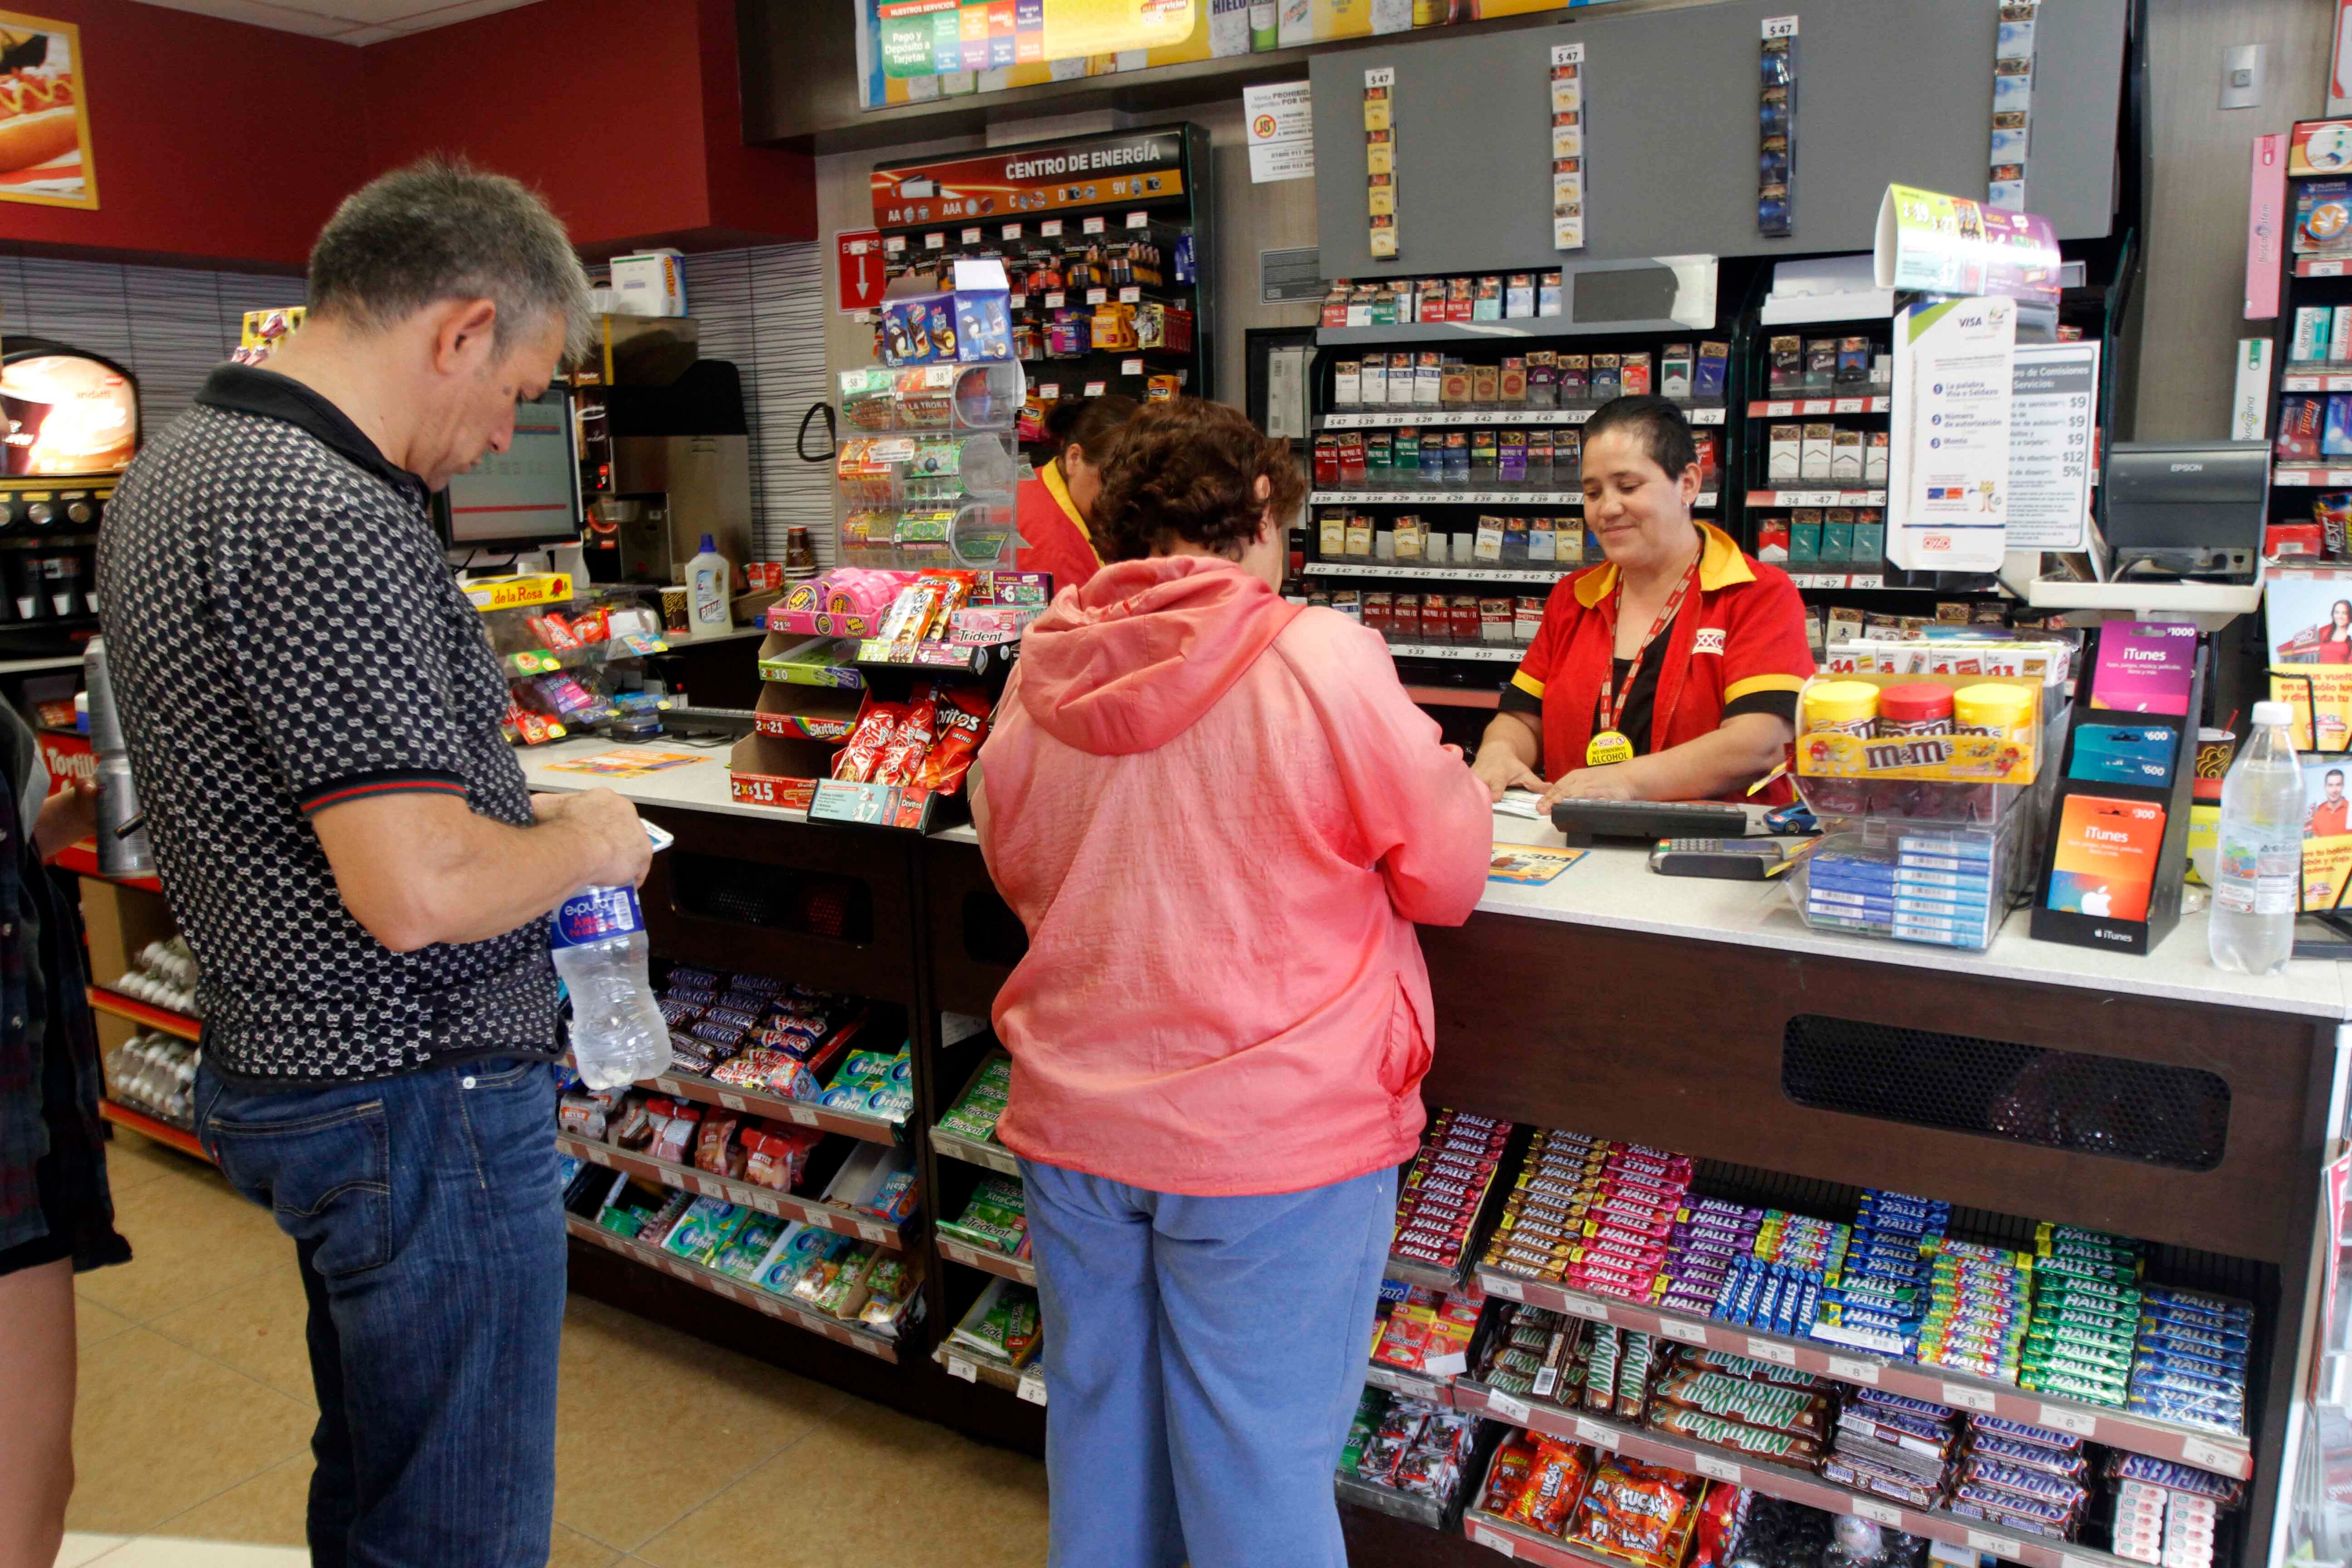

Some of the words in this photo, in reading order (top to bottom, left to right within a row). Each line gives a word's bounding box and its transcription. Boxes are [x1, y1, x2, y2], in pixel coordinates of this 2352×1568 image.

[890, 7, 922, 16] NUESTROS
[923, 1, 955, 13] SERVICIOS
[893, 32, 914, 42] Pago
[916, 32, 922, 42] y
[885, 43, 923, 55] Depósito
[893, 53, 925, 64] Tarjetas
[1272, 89, 1311, 98] PROHIBID
[1006, 158, 1065, 180] CENTRO
[1068, 156, 1089, 170] DE
[1091, 140, 1160, 169] ENERGÍA
[888, 210, 900, 222] AA
[943, 202, 961, 215] AAA
[1009, 195, 1016, 207] C
[1058, 189, 1065, 202] D
[1112, 181, 1127, 195] 9V
[1960, 317, 1982, 328] VISA
[2070, 396, 2086, 408] $9
[2069, 415, 2085, 427] $9
[2068, 433, 2083, 445] $9
[2063, 451, 2083, 462] $12
[2063, 466, 2082, 477] 5%
[2170, 464, 2203, 472] EPSON
[495, 590, 506, 604] de
[507, 589, 516, 602] la
[517, 586, 542, 601] Rosa
[1001, 585, 1015, 603] $6
[959, 629, 1004, 643] Trident
[2167, 627, 2195, 637] $1000
[2123, 647, 2166, 661] iTunes
[935, 708, 980, 732] oritos
[809, 723, 846, 736] Skittles
[2144, 731, 2168, 741] $600
[1592, 752, 1628, 764] ALCOHOL
[1864, 739, 1955, 771] m&m's
[901, 799, 922, 809] Doritos
[2133, 808, 2156, 820] $300
[2085, 826, 2128, 843] iTunes
[2103, 929, 2133, 942] iTunes
[848, 1059, 887, 1076] Orbit
[823, 1093, 860, 1111] Orbit
[870, 1093, 912, 1109] Orbit
[947, 1117, 985, 1137] Trident
[1456, 1113, 1497, 1128] HALLS
[1553, 1129, 1592, 1142] HALLS
[1445, 1139, 1485, 1155] HALLS
[1628, 1146, 1670, 1161] HALLS
[1422, 1179, 1467, 1196] HALLS
[1530, 1179, 1577, 1196] HALLS
[1607, 1199, 1654, 1217] HALLS
[1700, 1200, 1744, 1215] HALLS
[1879, 1203, 1927, 1218] HALLS
[967, 1216, 1011, 1238] Trident
[1517, 1218, 1563, 1236] HALLS
[1692, 1211, 1740, 1229] HALLS
[1399, 1232, 1444, 1249] HALLS
[1600, 1228, 1647, 1245] HALLS
[2056, 1227, 2112, 1246] HALLS
[1399, 1245, 1440, 1261] HALLS
[1507, 1248, 1549, 1264] HALLS
[1945, 1241, 1996, 1258] HALLS
[1585, 1253, 1632, 1270] HALLS
[2037, 1257, 2095, 1277] HALLS
[1717, 1269, 1739, 1305] HALLS
[1843, 1277, 1898, 1295] HALLS
[2065, 1278, 2118, 1297] HALLS
[1760, 1278, 1778, 1316] HALLS
[2170, 1293, 2226, 1312] HALLS
[1841, 1310, 1900, 1329] HALLS
[1957, 1306, 2010, 1324] HALLS
[1383, 1332, 1421, 1349] Trident
[2163, 1324, 2222, 1345] HALLS
[1940, 1353, 1996, 1374] HALLS
